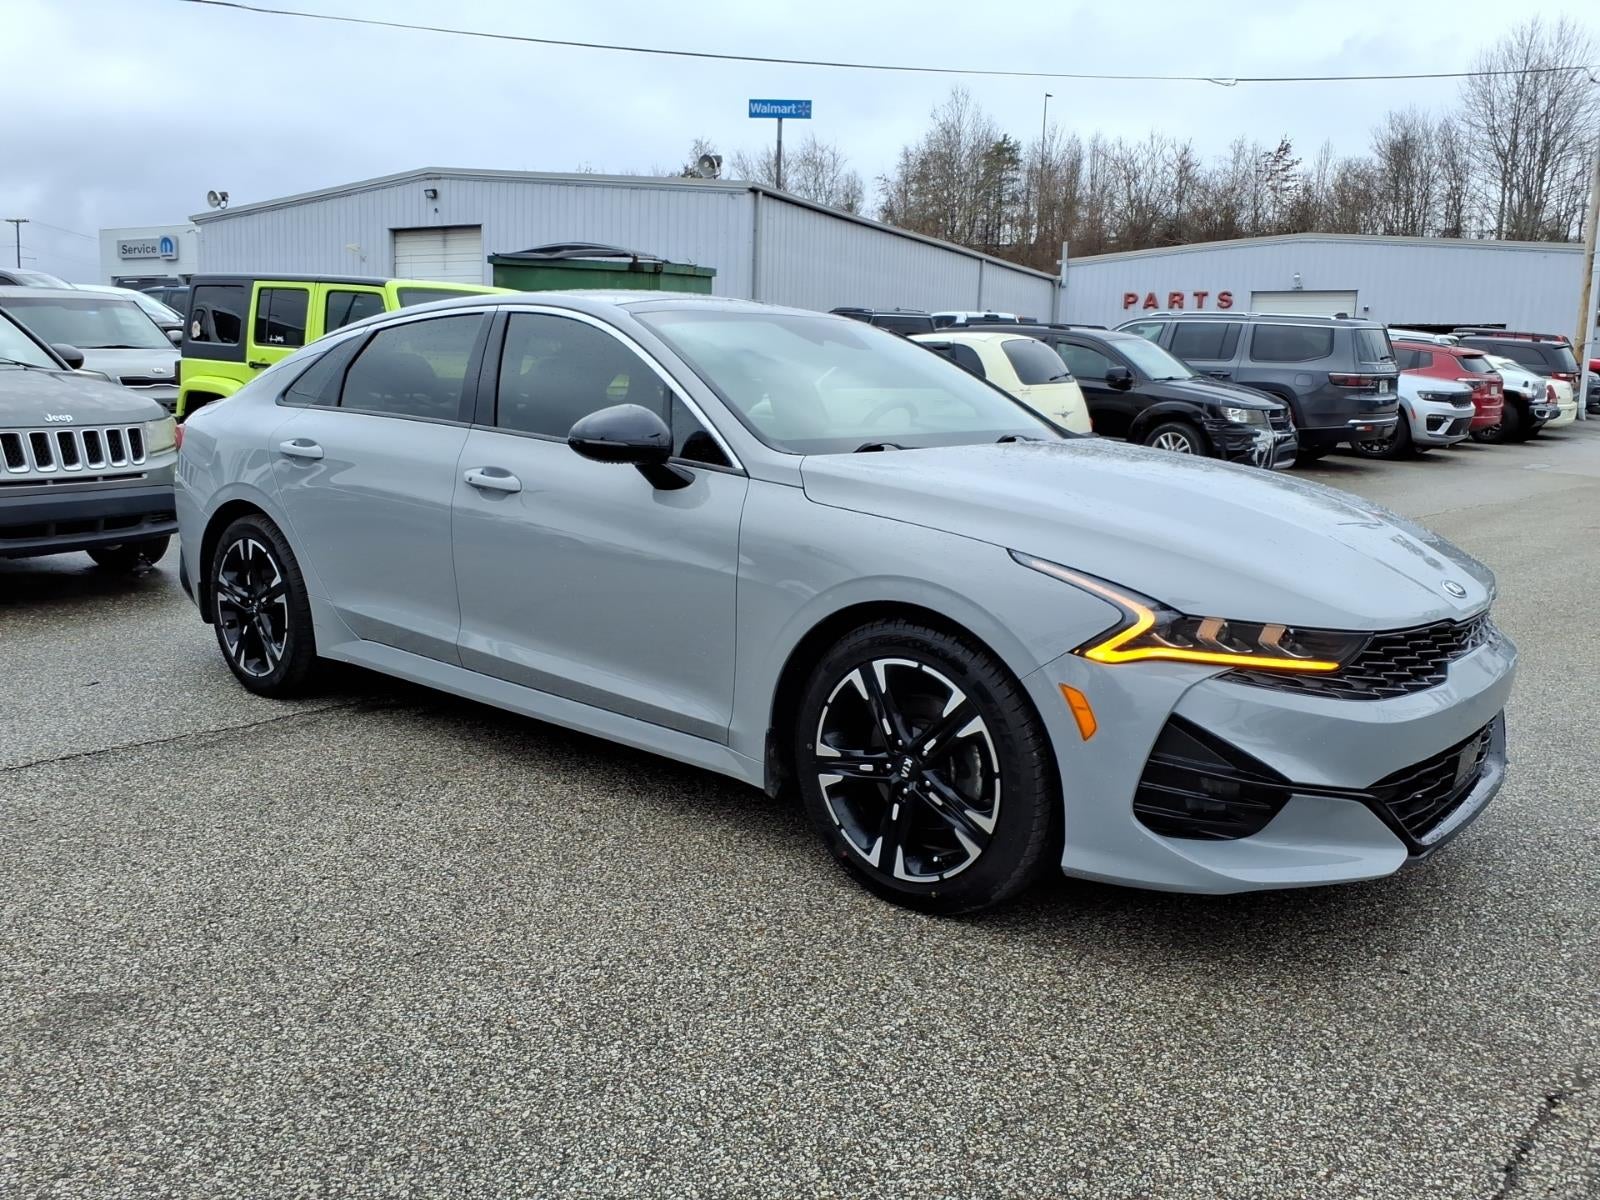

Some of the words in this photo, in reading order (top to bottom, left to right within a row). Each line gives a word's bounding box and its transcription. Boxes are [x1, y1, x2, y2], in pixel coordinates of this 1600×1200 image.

[750, 102, 797, 114] Walmart
[121, 243, 157, 254] Service
[1123, 291, 1234, 310] PARTS
[44, 413, 73, 423] Jeep
[900, 757, 913, 778] KIA
